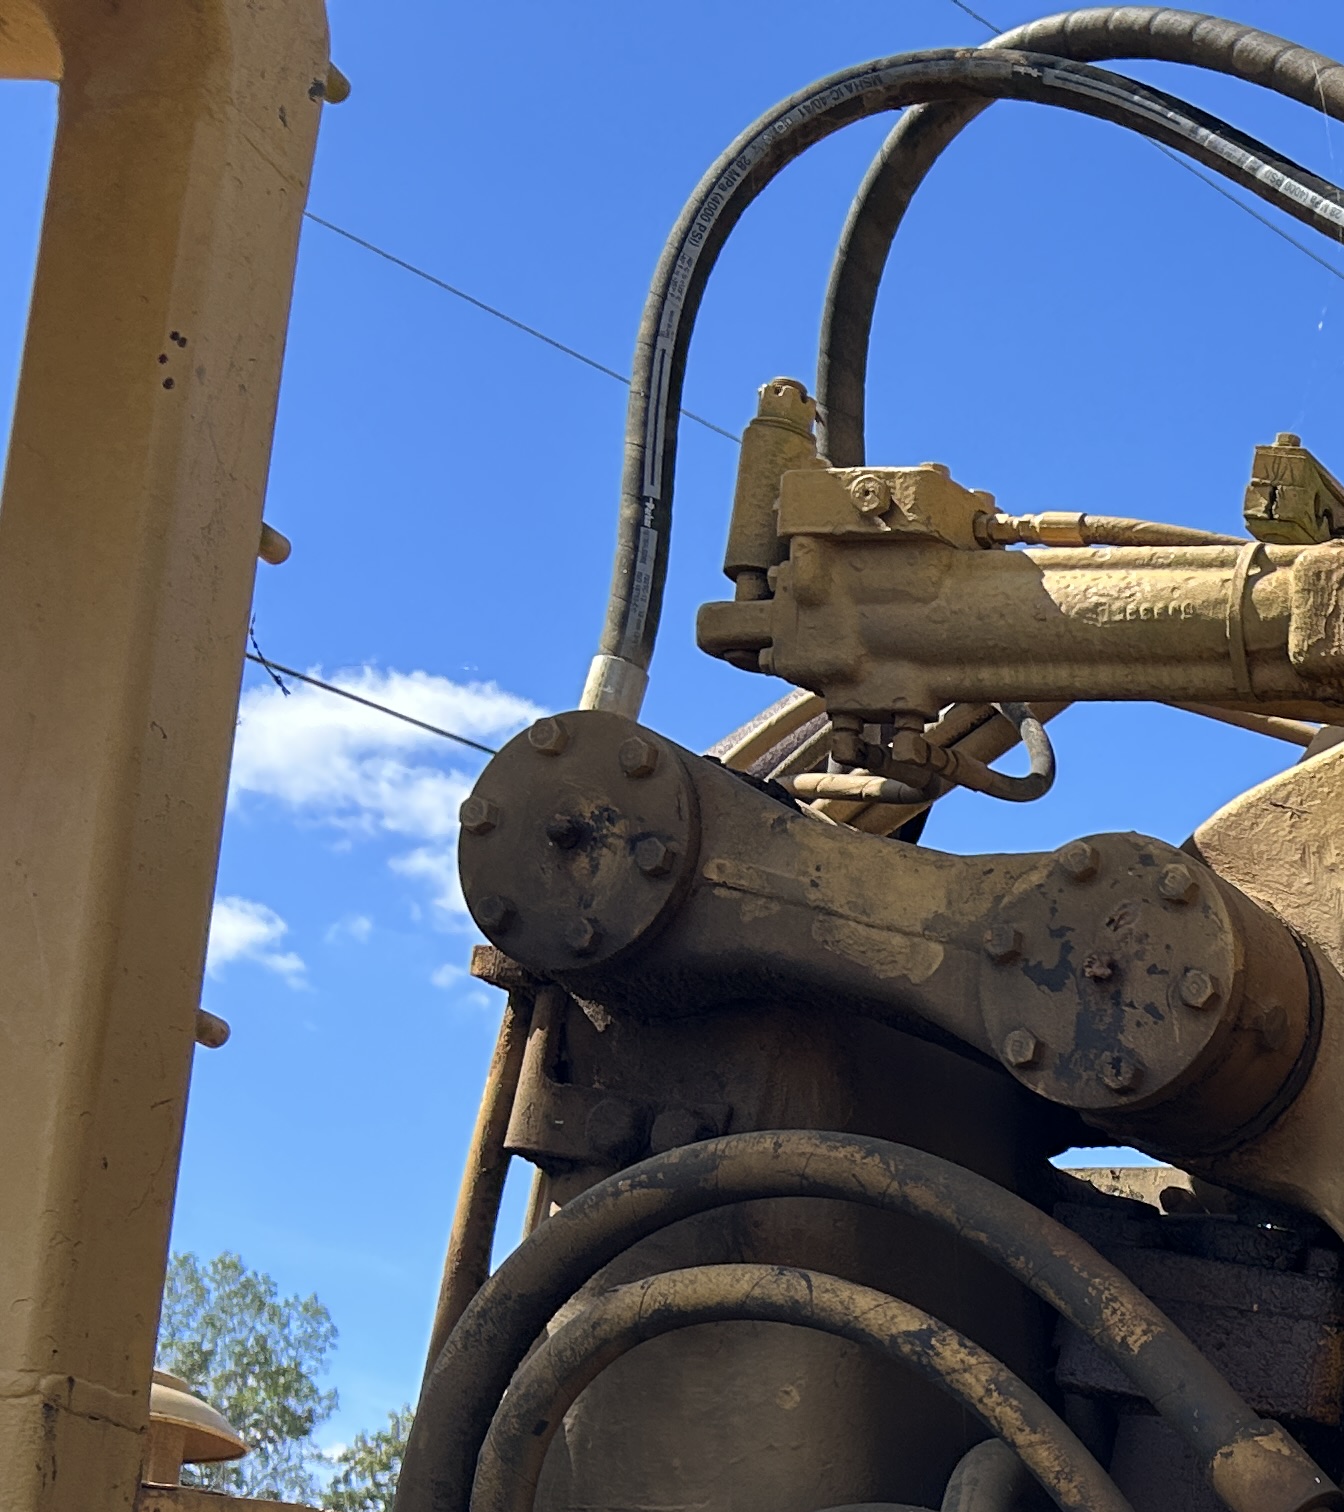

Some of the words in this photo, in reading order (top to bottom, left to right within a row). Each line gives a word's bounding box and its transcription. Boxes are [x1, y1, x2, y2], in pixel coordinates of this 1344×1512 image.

[844, 74, 884, 95] MSHA
[735, 154, 752, 174] 28
[699, 191, 724, 223] (4000
[687, 220, 708, 249] PSI)
